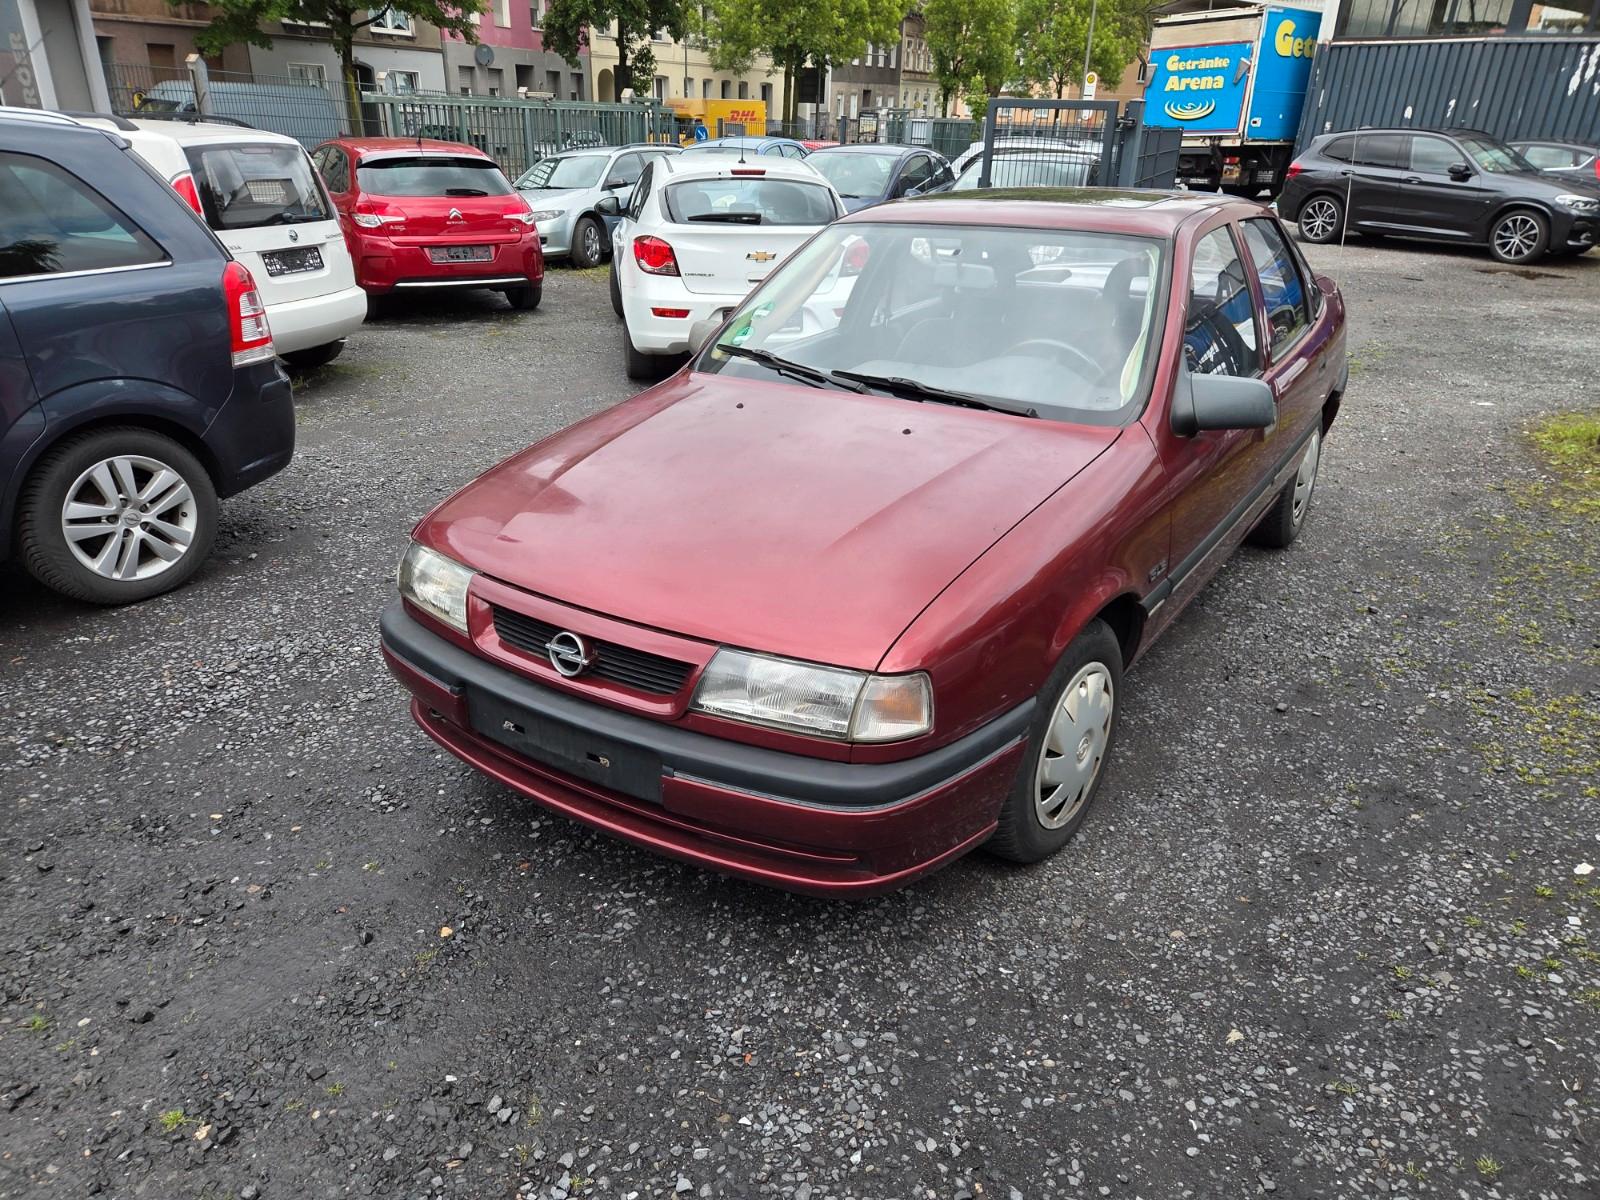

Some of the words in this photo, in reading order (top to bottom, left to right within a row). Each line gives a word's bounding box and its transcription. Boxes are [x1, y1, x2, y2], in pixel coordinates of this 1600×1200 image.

[1274, 18, 1316, 58] Get
[1166, 54, 1230, 71] Getränke
[1164, 75, 1225, 91] Arena
[729, 110, 757, 122] DHL
